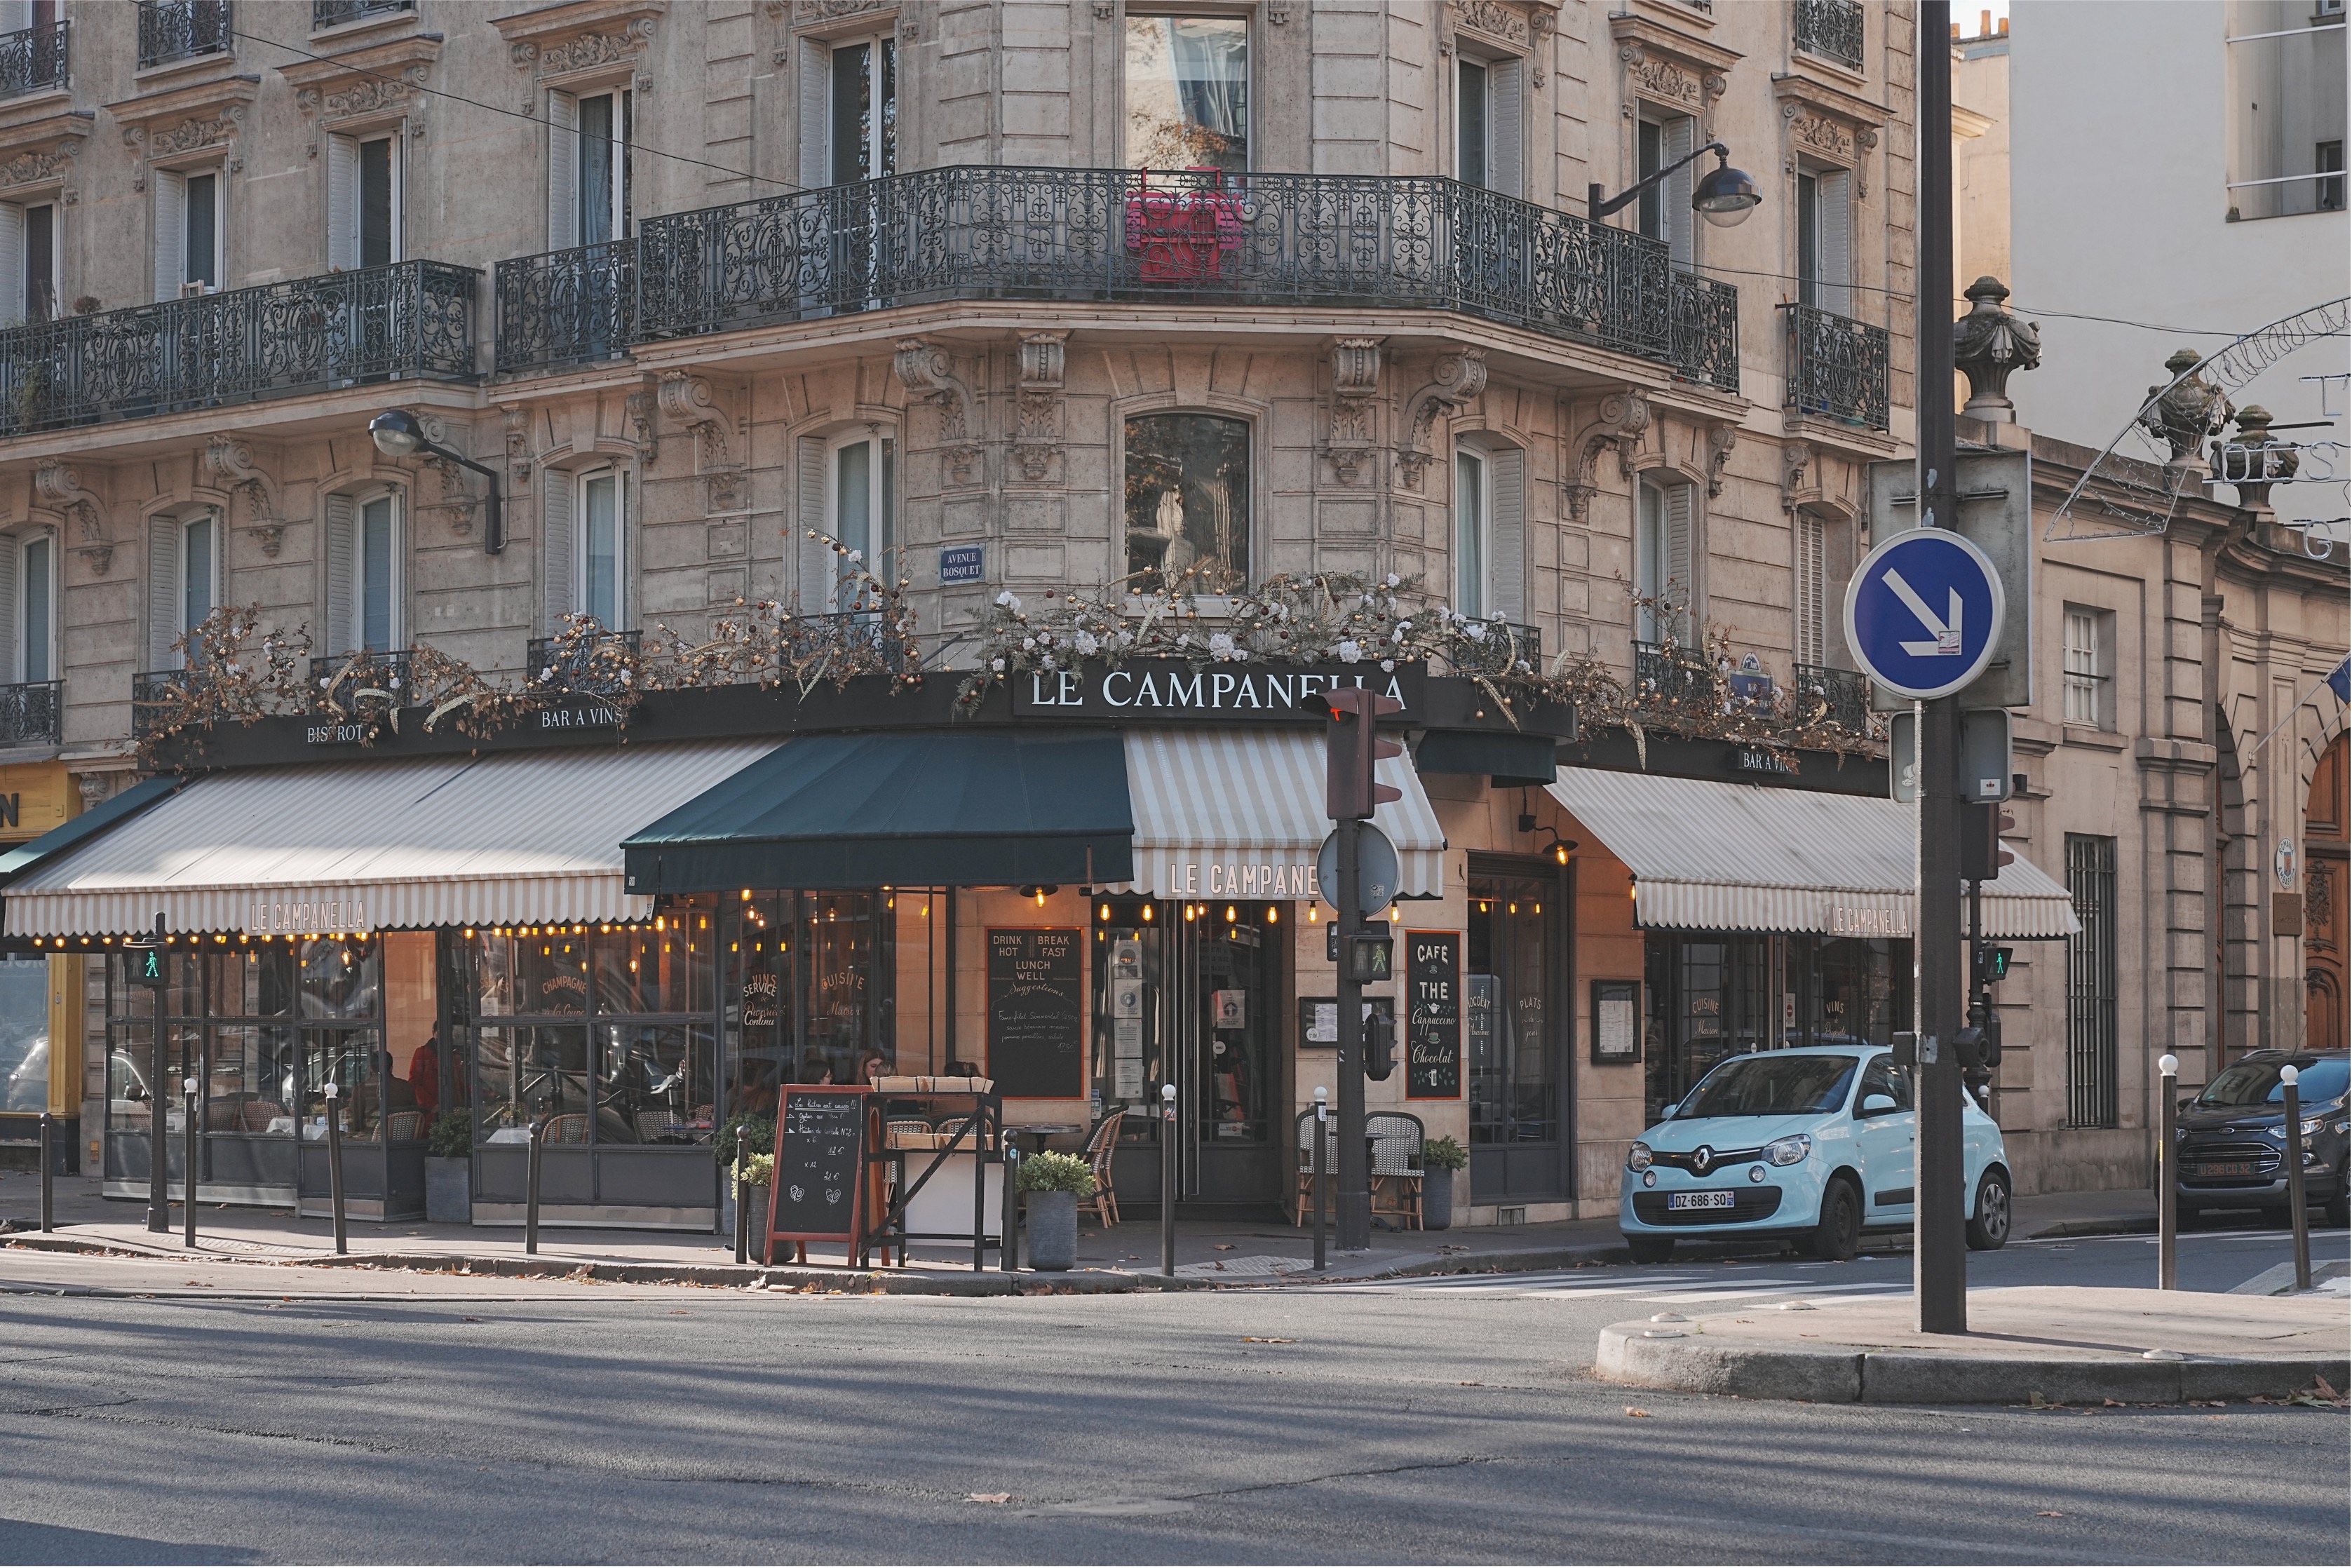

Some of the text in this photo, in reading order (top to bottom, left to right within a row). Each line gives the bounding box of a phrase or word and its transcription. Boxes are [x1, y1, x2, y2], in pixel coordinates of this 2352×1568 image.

[947, 553, 976, 564] AVENUE
[942, 565, 980, 577] BOSQUET
[1032, 670, 1083, 706] LE
[542, 708, 623, 727] BAR A VINS
[1744, 752, 1762, 769] BAR
[1765, 755, 1771, 770] A
[1170, 863, 1318, 895] LE CAMPANE
[251, 900, 365, 931] LE CAMPANELLA
[1832, 907, 1908, 934] LE CAMPANELLA
[993, 935, 1069, 945] DRINK BREAK
[999, 947, 1066, 957] HOT FAST
[1417, 945, 1448, 965] CAFÉ
[1015, 961, 1050, 970] LUNCH
[752, 973, 776, 987] VINS
[1016, 971, 1045, 980] WELL
[542, 975, 587, 994] CHAMPAGNE
[743, 982, 777, 997] SERVICE
[1004, 982, 1064, 997] Suggestions
[1419, 981, 1449, 1000] THÉ
[1468, 996, 1490, 1010] OCOLAT
[1520, 997, 1541, 1011] PLATS
[1692, 997, 1719, 1015] CUISINE
[1826, 1001, 1844, 1014] VINS
[744, 1011, 774, 1026] Continu
[1412, 1008, 1456, 1036] Cappuccino
[1694, 1019, 1718, 1035] Maison
[1410, 1040, 1454, 1064] Chocolat
[1675, 1194, 1726, 1208] DZ-686-SQ
